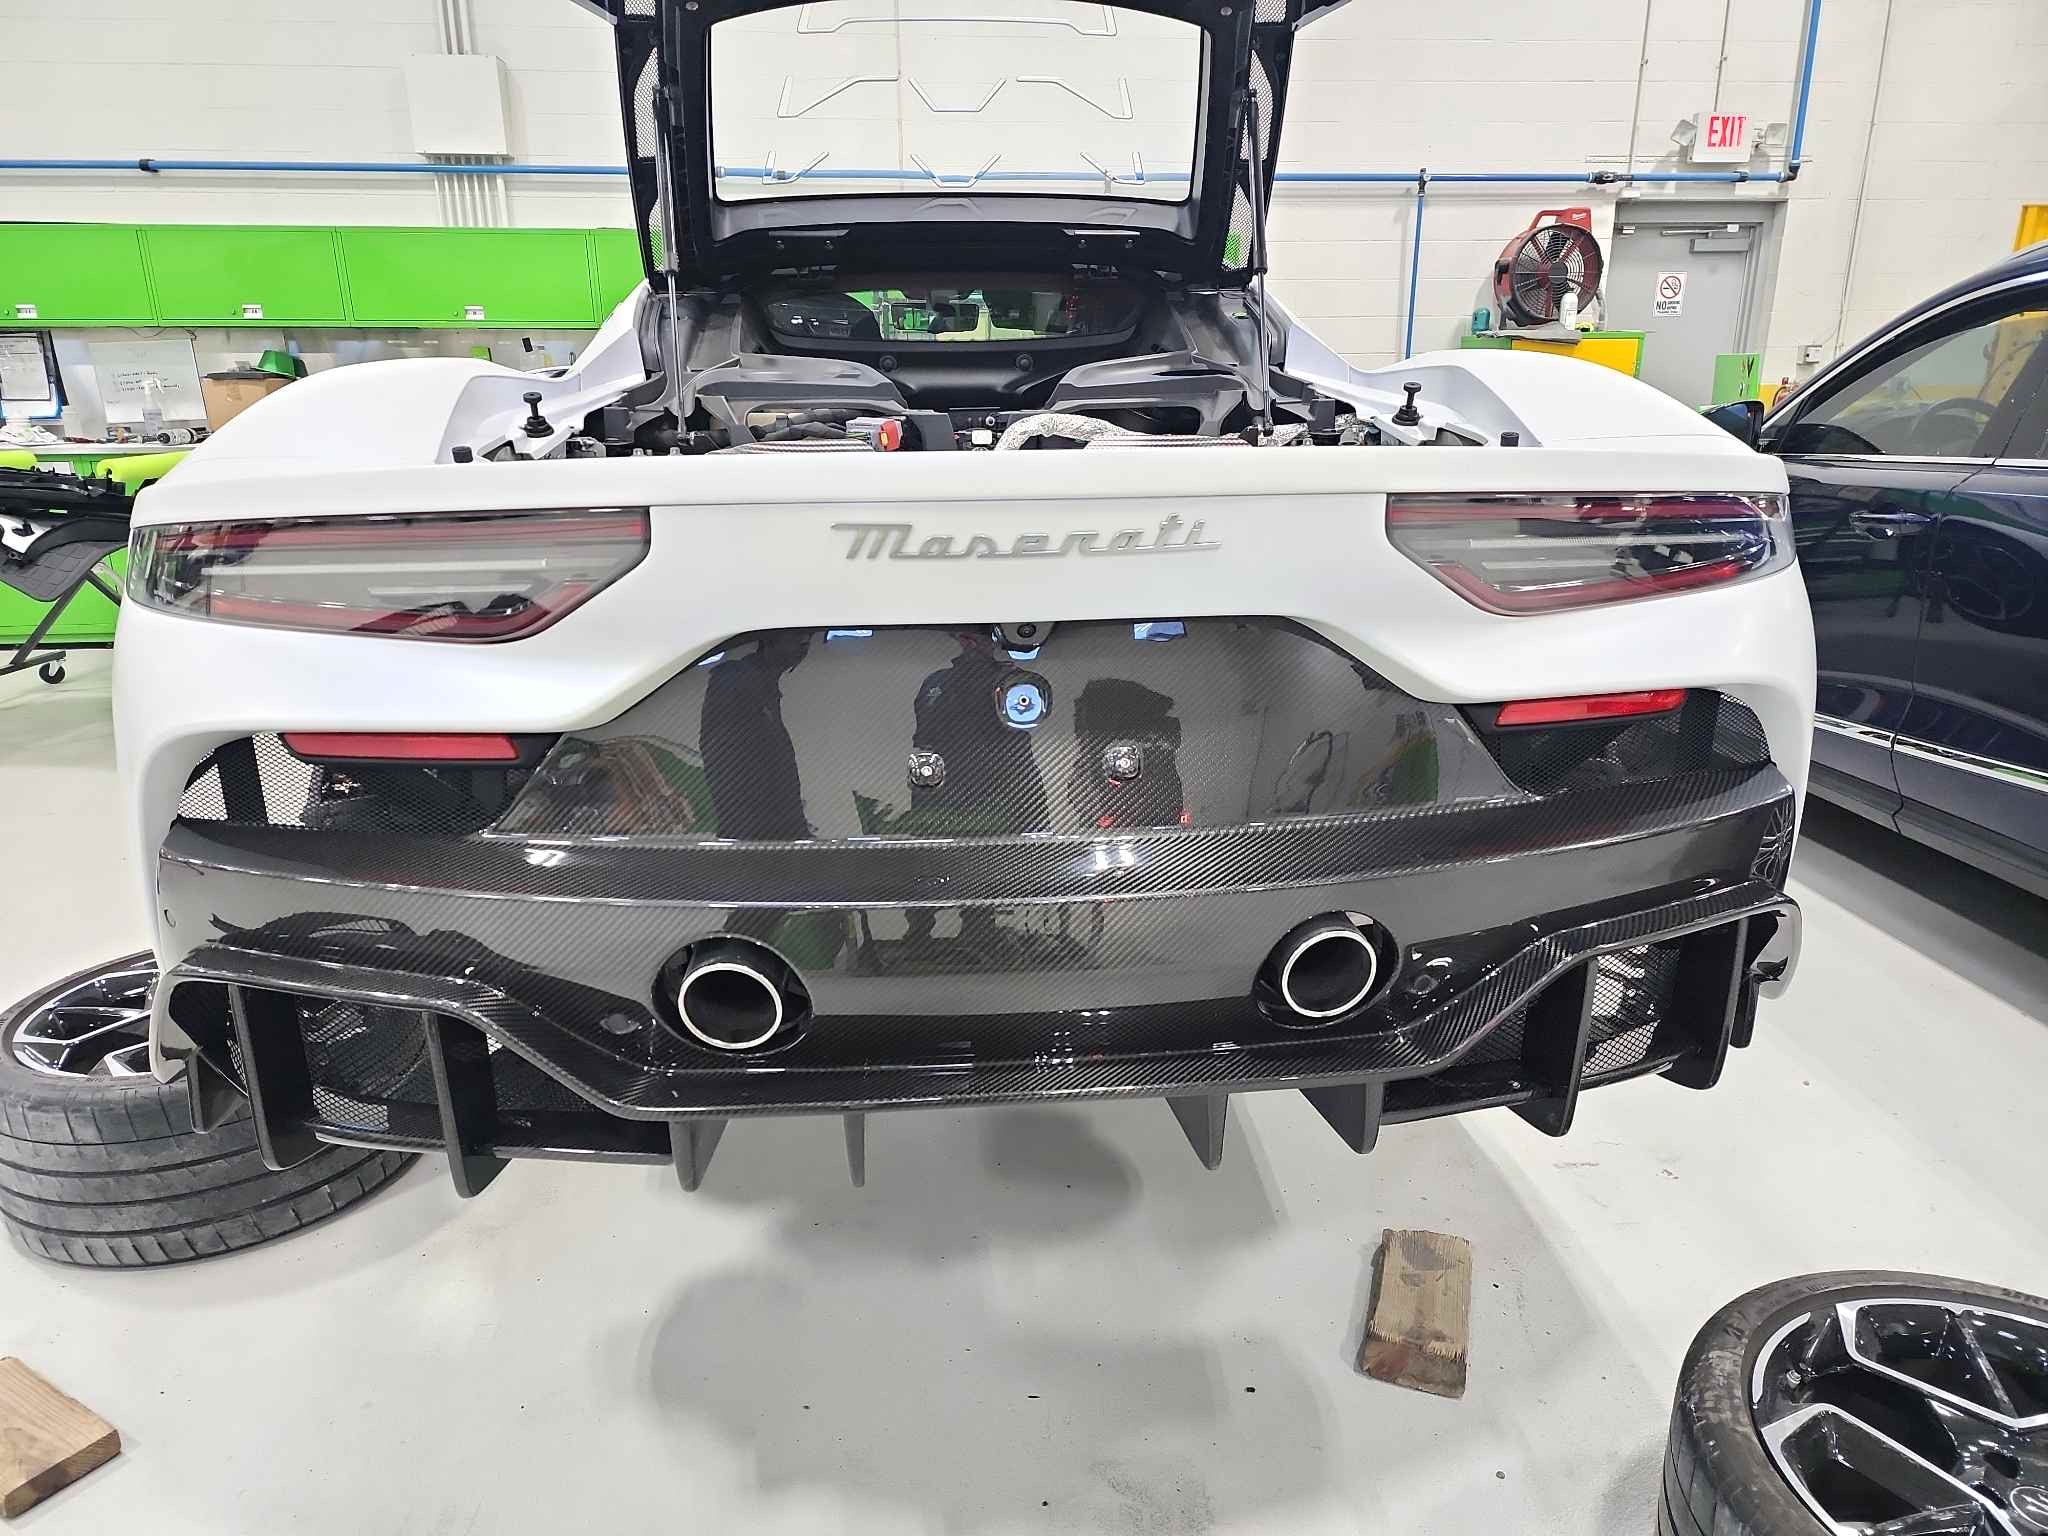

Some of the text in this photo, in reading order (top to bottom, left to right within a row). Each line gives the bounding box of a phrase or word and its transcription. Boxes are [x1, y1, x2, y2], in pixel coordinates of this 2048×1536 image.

[1707, 116, 1746, 147] EXIT
[1656, 300, 1667, 311] NO
[831, 512, 1223, 560] Maserati
